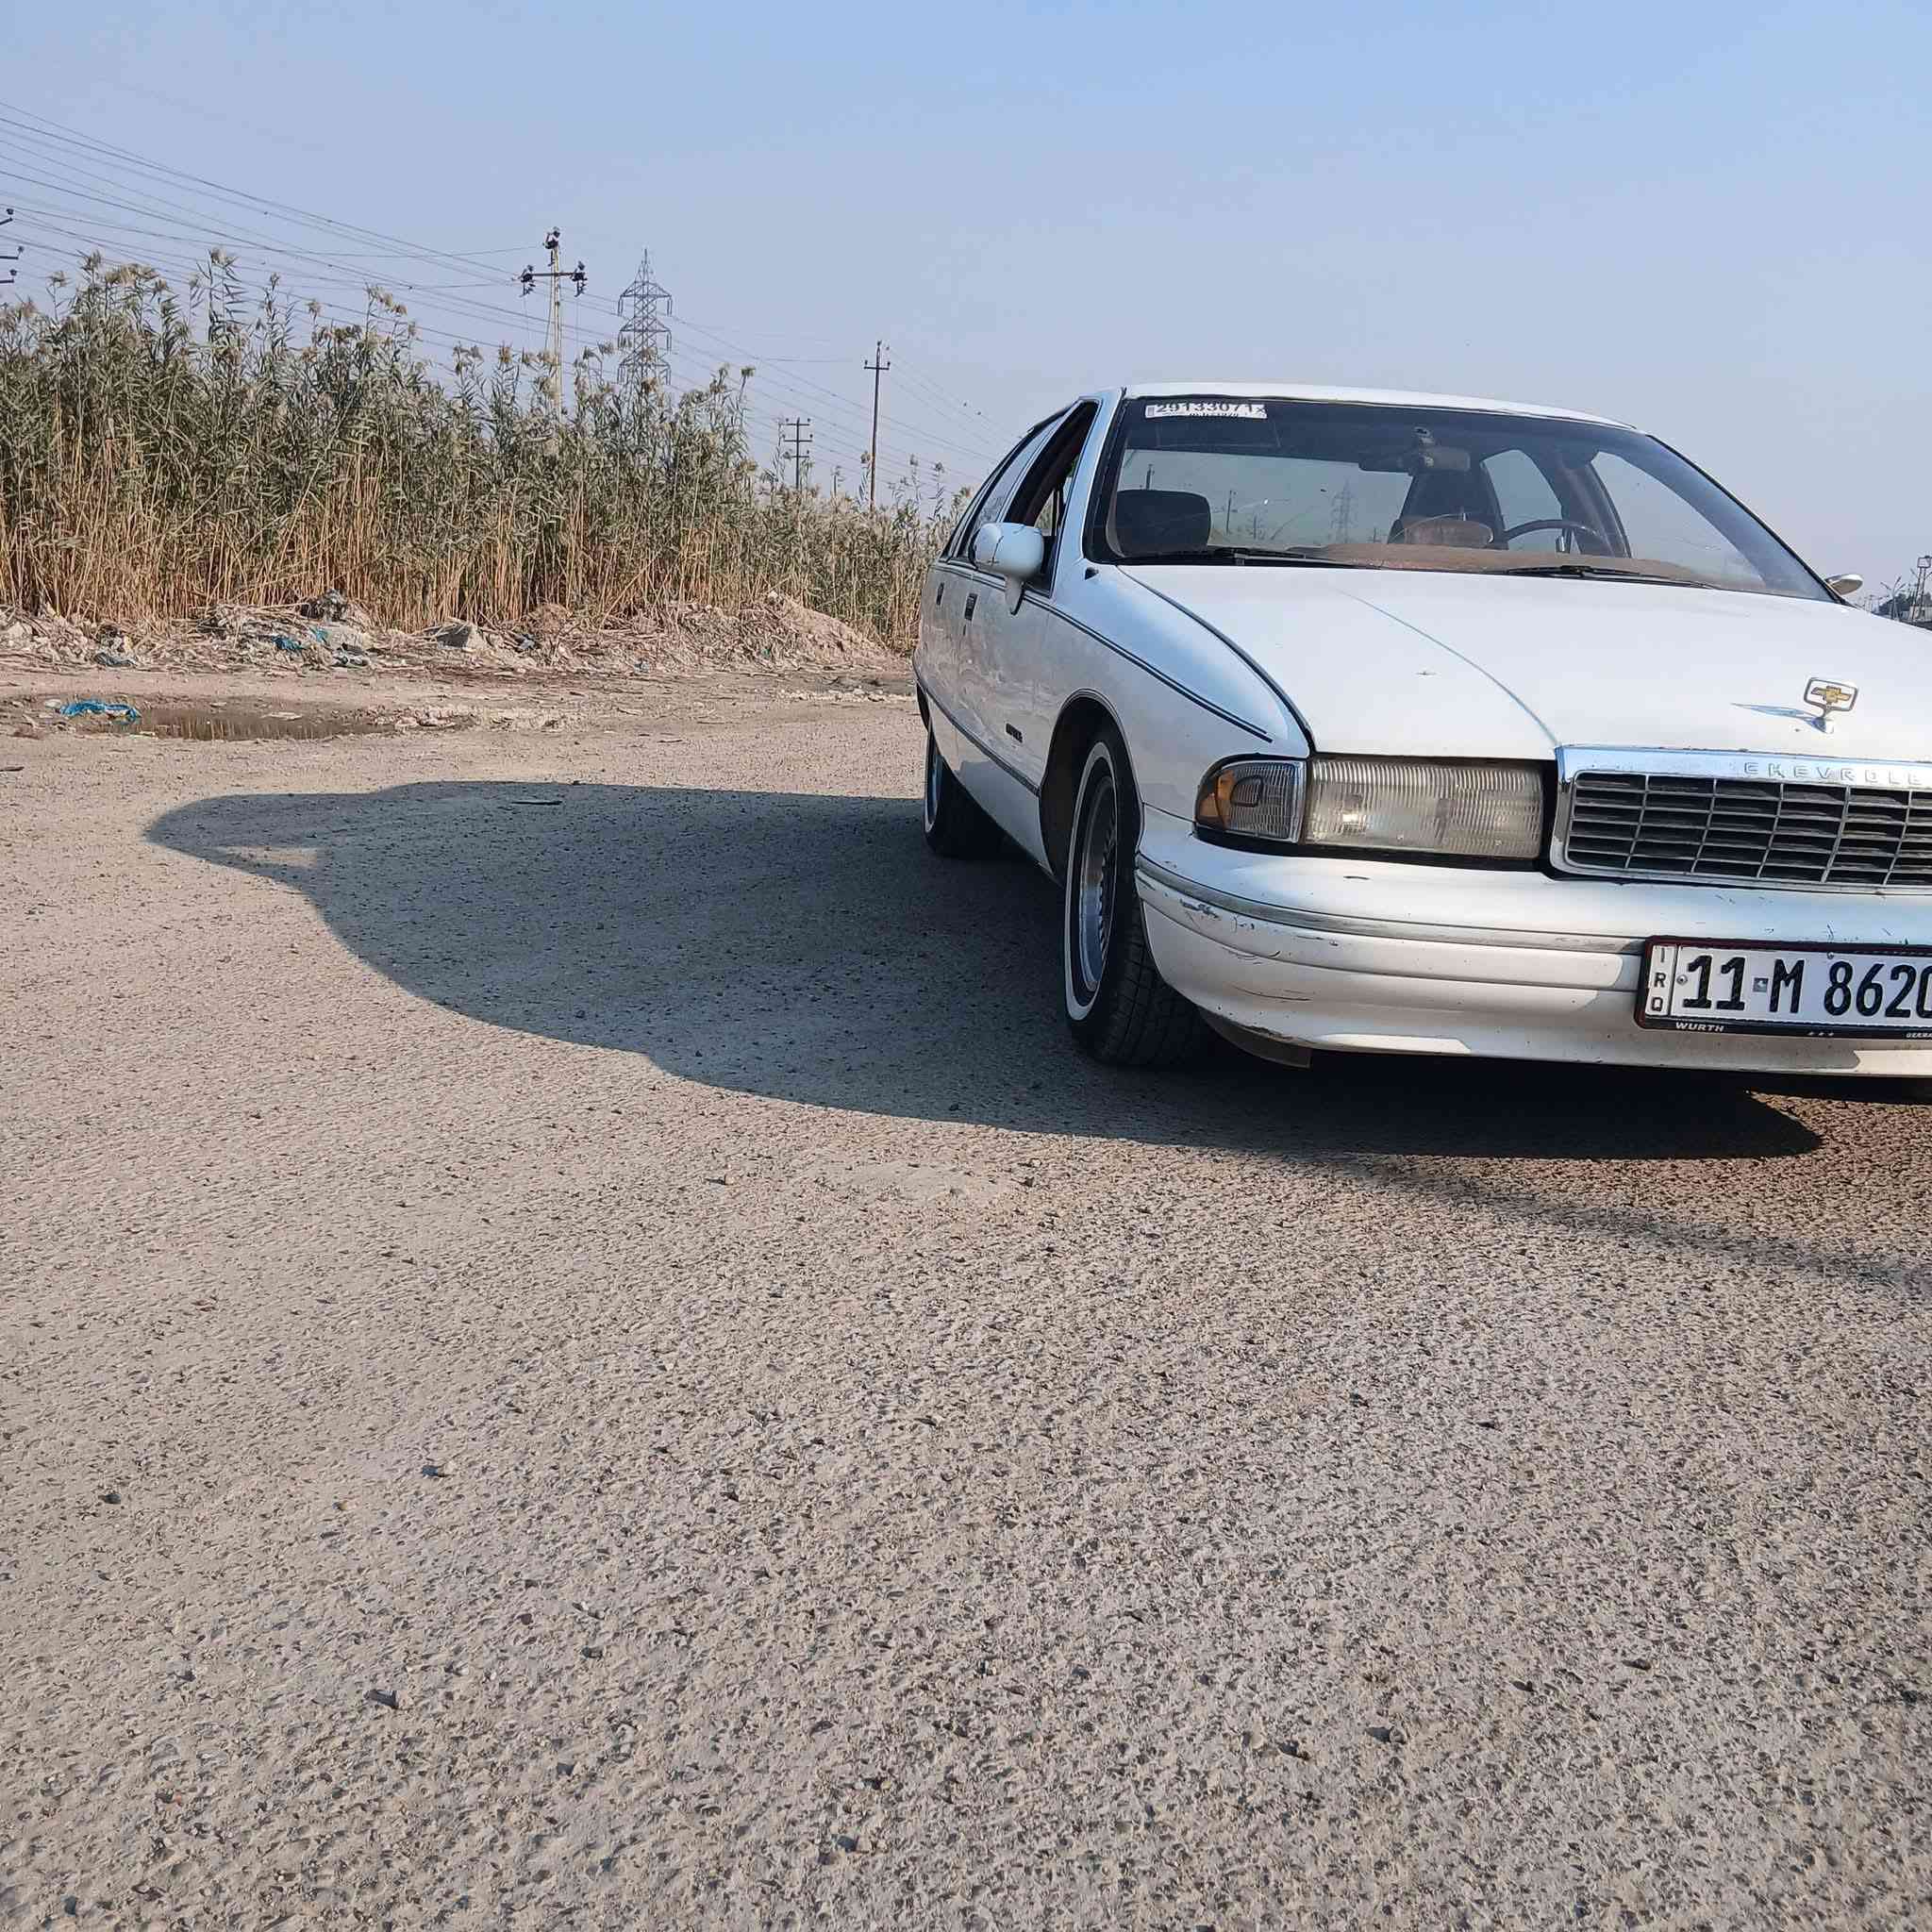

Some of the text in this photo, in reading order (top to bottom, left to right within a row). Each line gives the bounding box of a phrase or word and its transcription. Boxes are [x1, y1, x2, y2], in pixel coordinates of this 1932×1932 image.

[1744, 761, 1924, 785] CHEVROLE
[1682, 955, 1747, 1010] 11
[1770, 958, 1806, 1013] M
